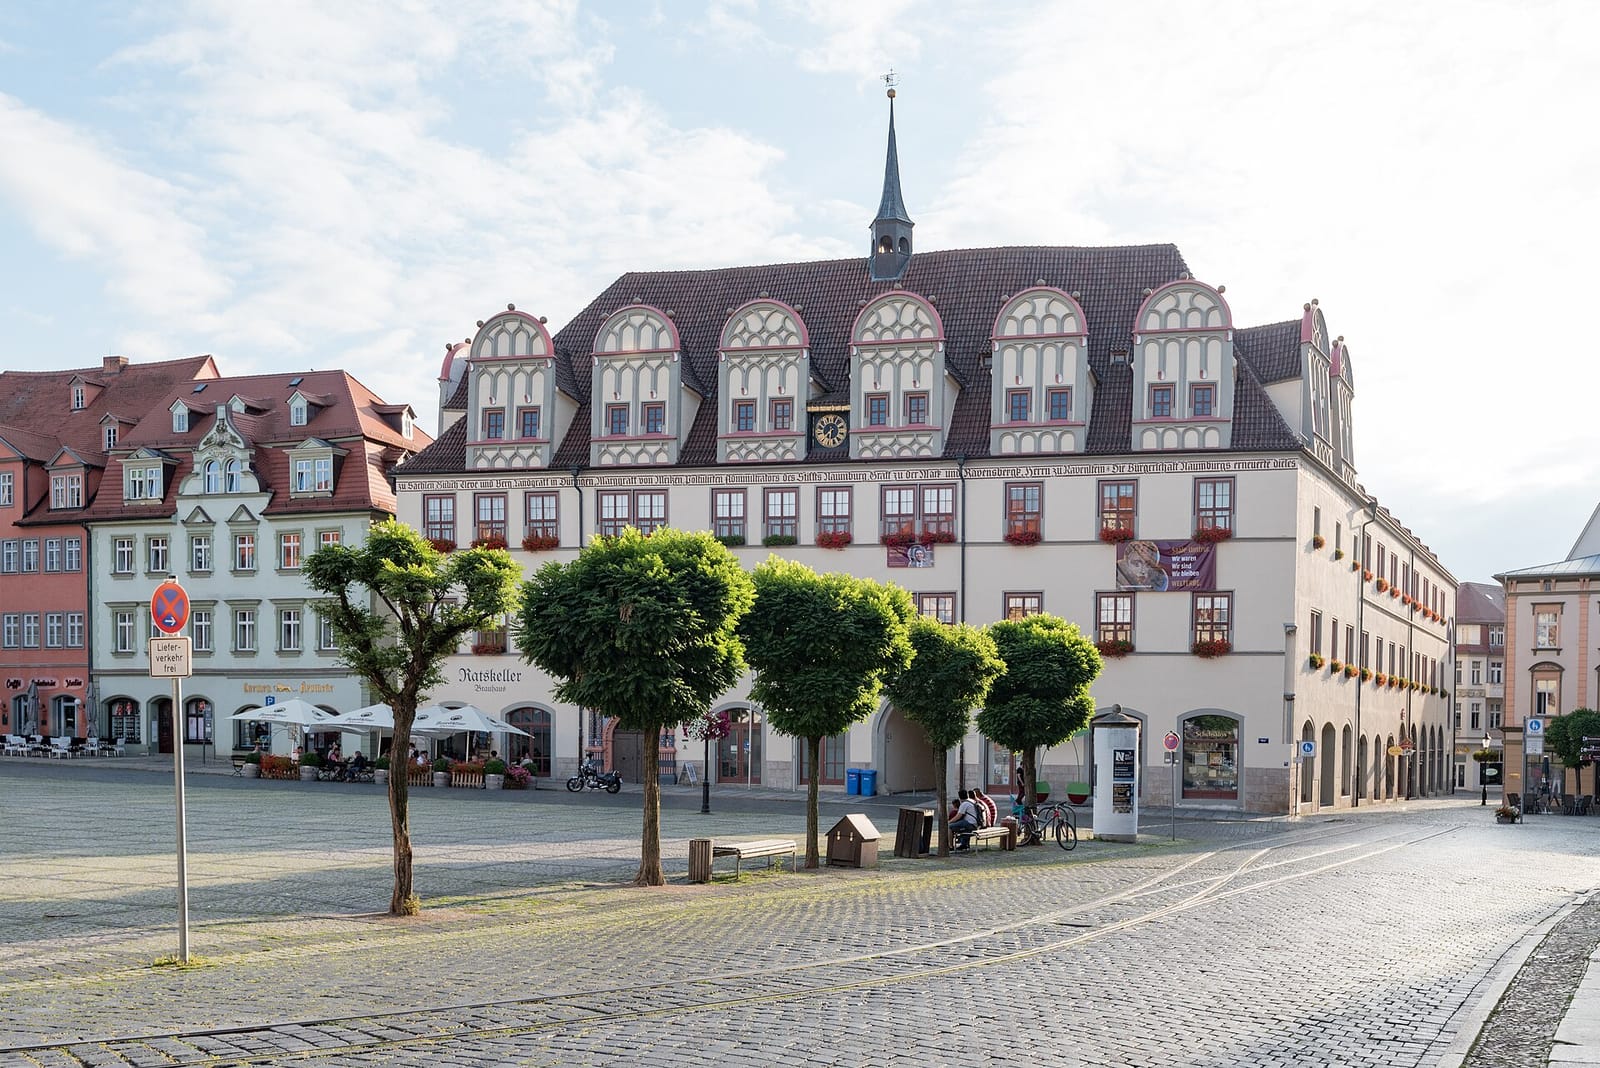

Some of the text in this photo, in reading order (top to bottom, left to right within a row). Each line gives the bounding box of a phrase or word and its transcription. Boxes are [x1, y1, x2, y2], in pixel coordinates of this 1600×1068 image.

[639, 476, 653, 485] von
[782, 472, 795, 481] des
[157, 643, 181, 652] Liefer-
[155, 653, 183, 663] verkehr
[164, 664, 177, 673] frei
[458, 668, 522, 682] Ratskeller
[474, 684, 507, 693] Brauhaus
[267, 697, 274, 705] P
